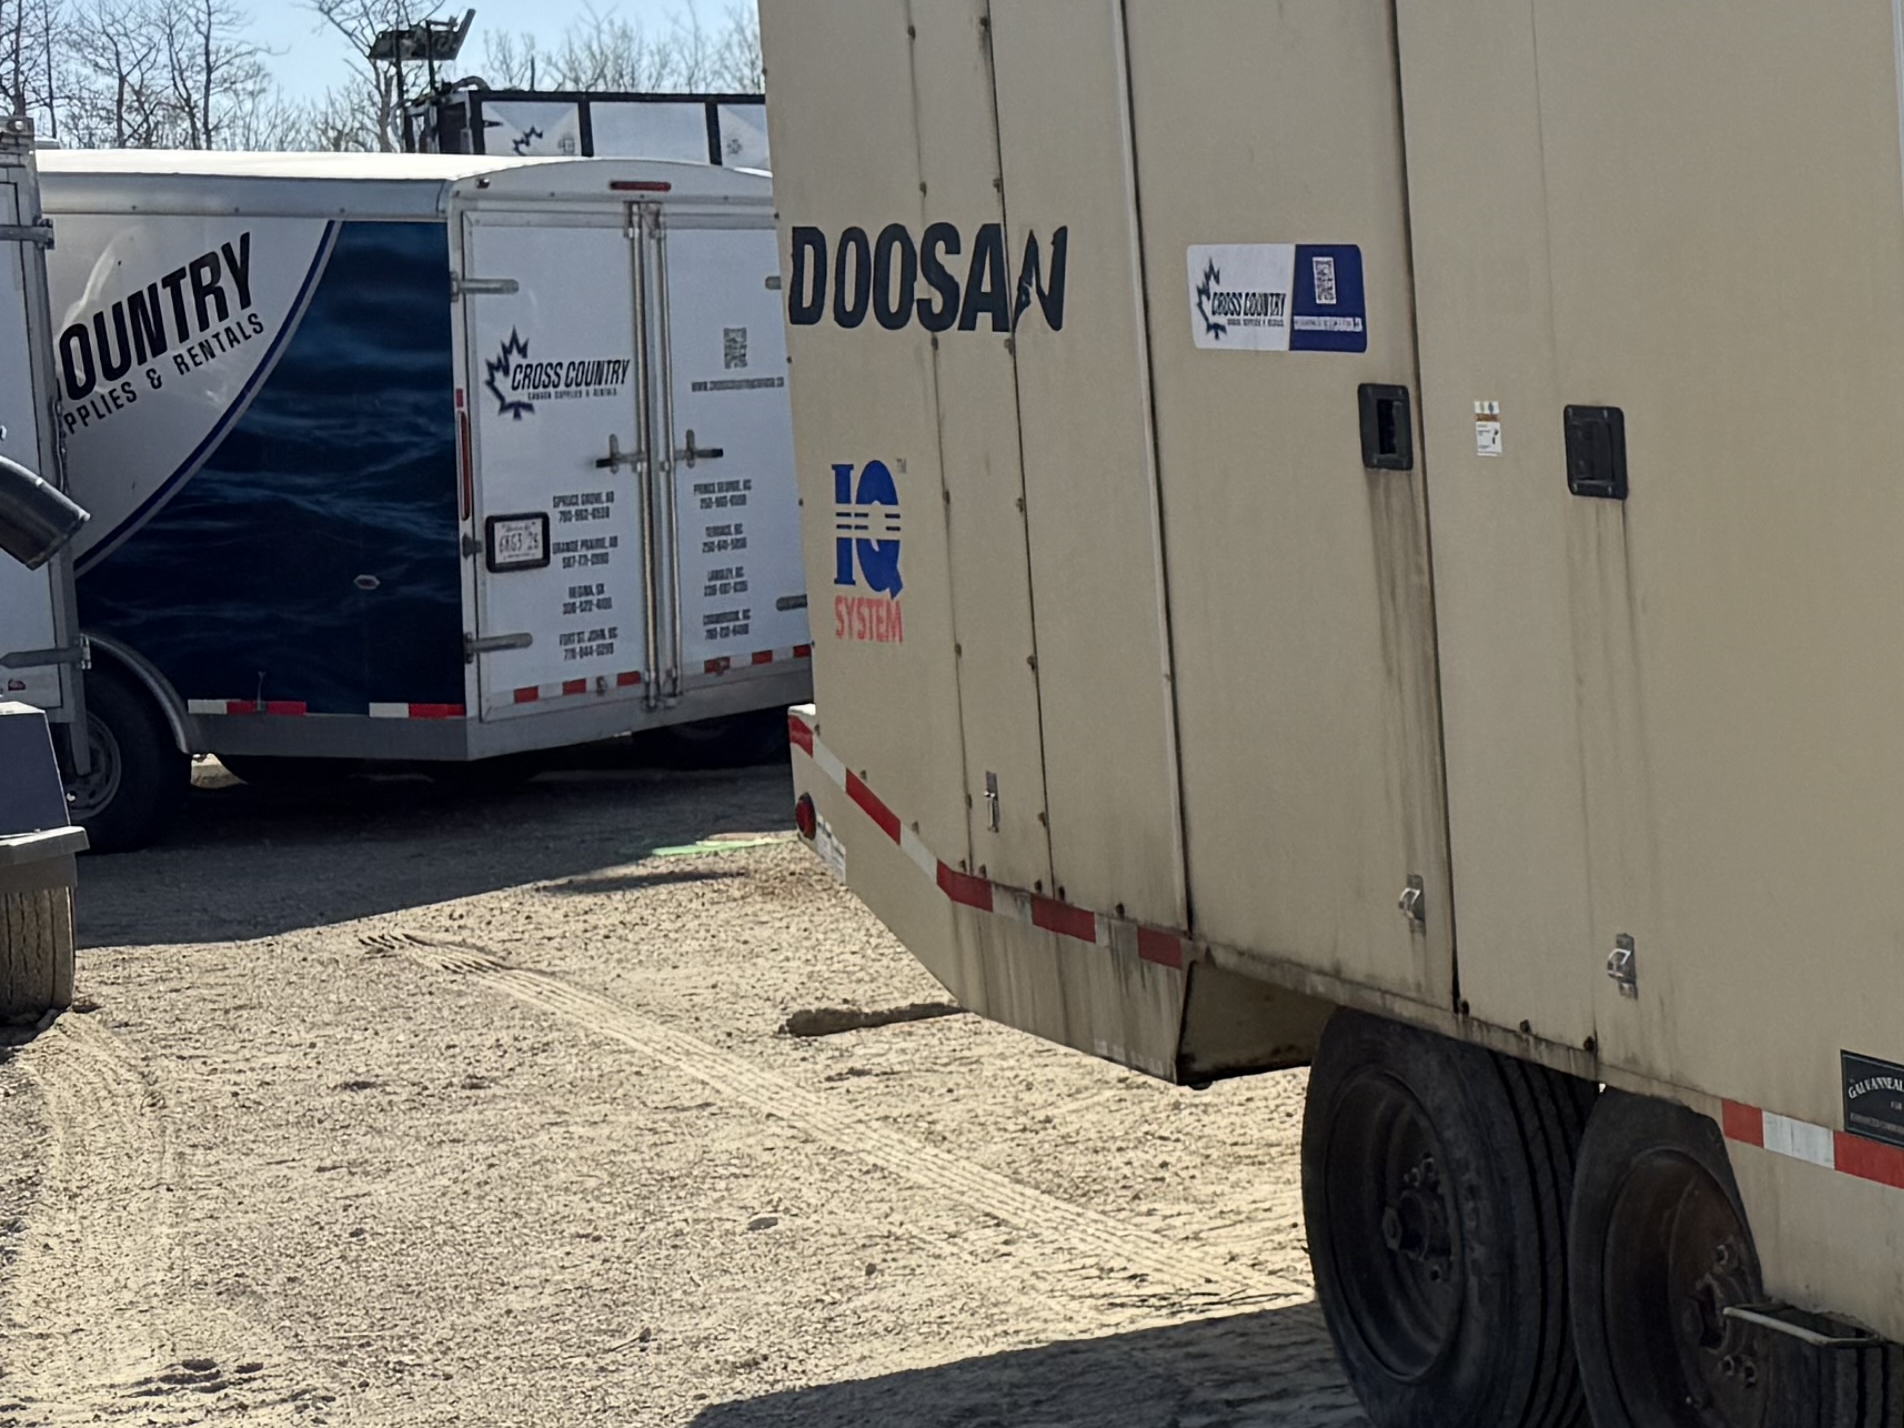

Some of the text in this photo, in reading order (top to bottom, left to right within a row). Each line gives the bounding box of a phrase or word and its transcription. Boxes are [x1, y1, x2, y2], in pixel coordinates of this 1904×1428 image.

[58, 231, 252, 401] OUNTRY
[788, 222, 1068, 332] DOOSAN
[60, 312, 265, 436] PPLIES & RENTALS
[511, 358, 631, 391] CROSS COUNTRY
[831, 460, 904, 600] IQ
[835, 594, 903, 643] SYSTEM
